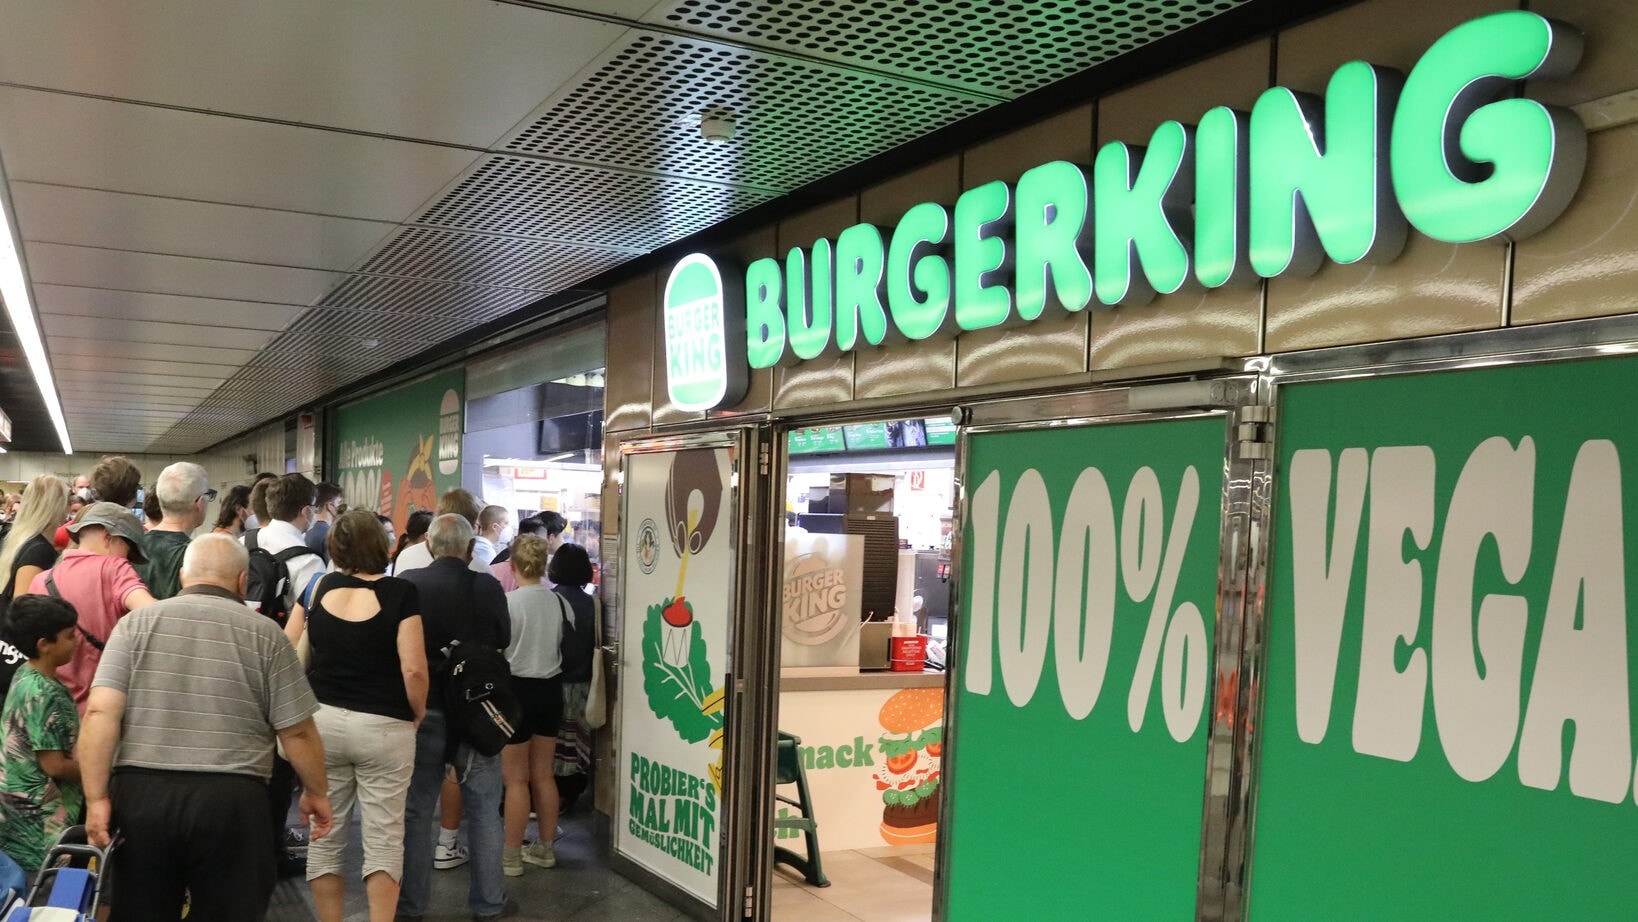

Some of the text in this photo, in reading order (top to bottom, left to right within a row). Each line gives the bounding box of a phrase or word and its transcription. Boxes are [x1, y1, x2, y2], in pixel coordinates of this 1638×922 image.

[668, 301, 720, 340] BURGER
[669, 333, 721, 378] KING
[783, 568, 844, 602] BURGER
[783, 584, 847, 624] KING
[965, 465, 1208, 743] 100%
[1289, 434, 1638, 808] VEGA
[799, 735, 875, 770] nack
[630, 751, 716, 812] PROBIER'S
[629, 782, 671, 834] MAL
[672, 798, 715, 850] MIT
